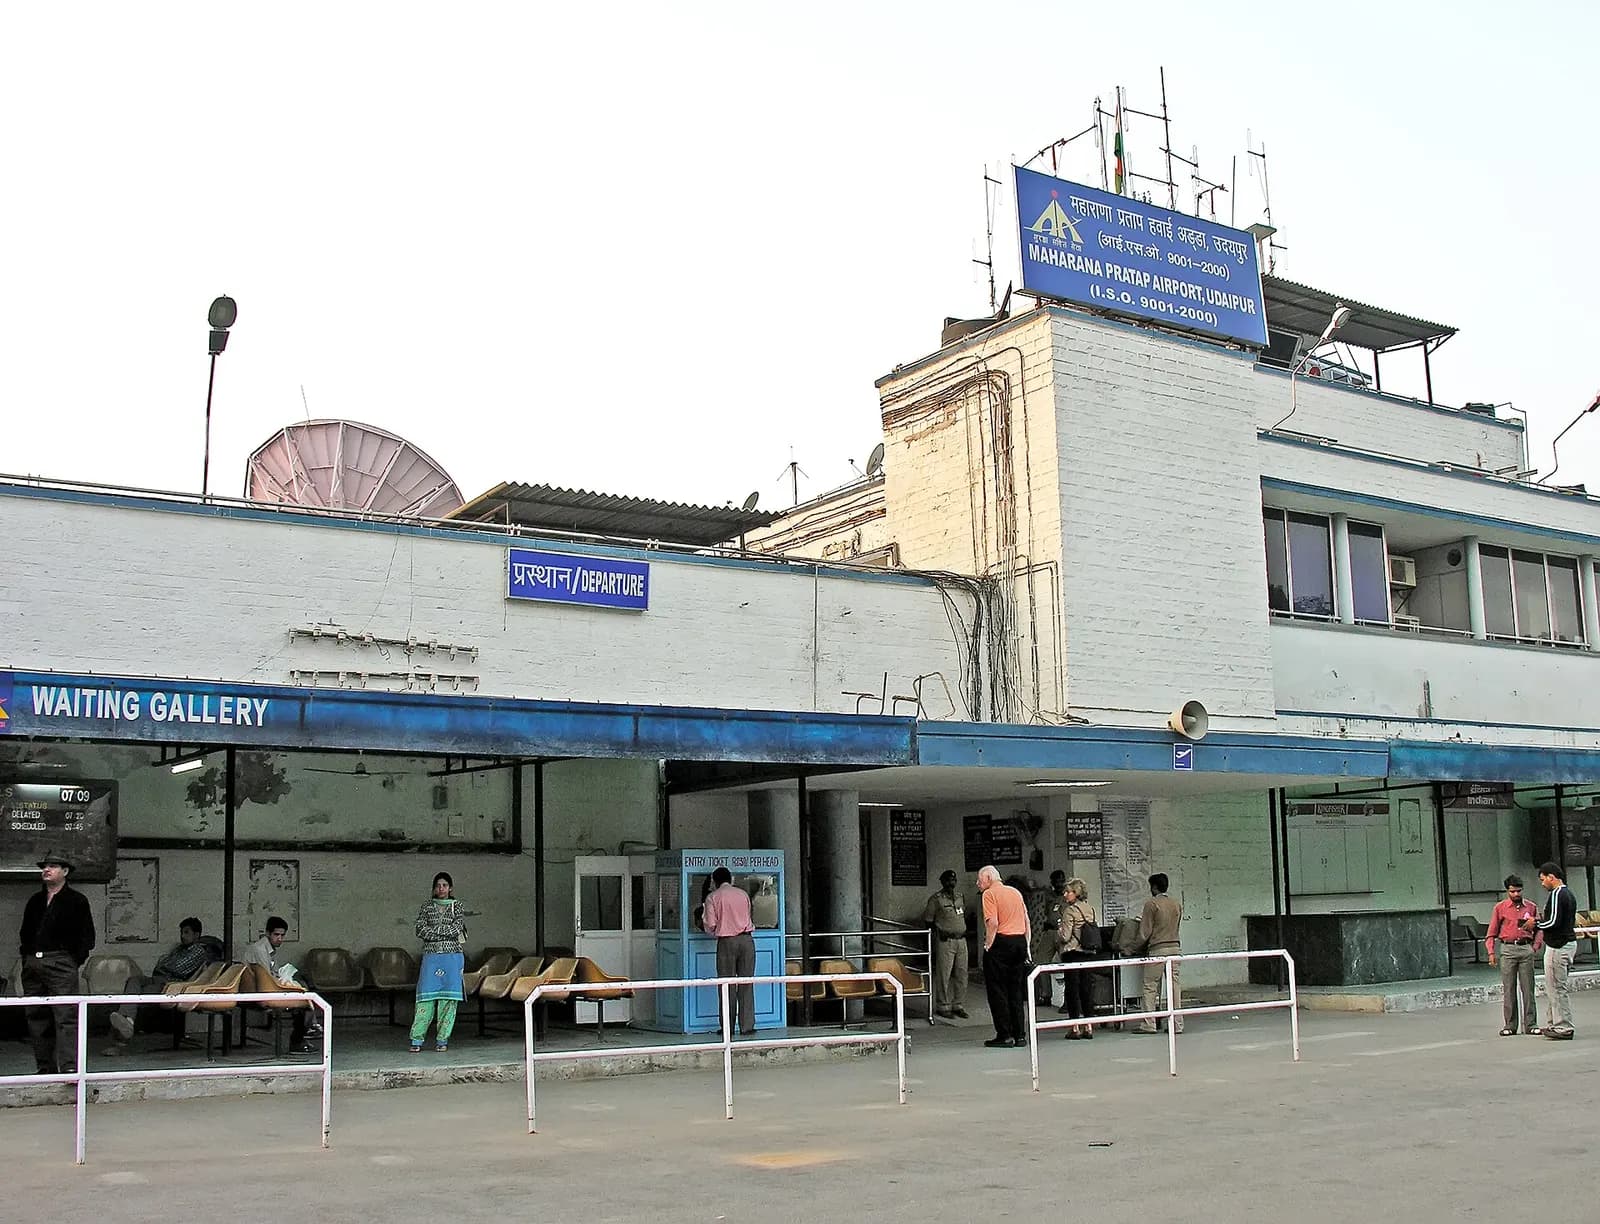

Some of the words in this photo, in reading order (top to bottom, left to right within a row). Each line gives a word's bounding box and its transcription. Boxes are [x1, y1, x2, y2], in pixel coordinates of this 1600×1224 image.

[1069, 195, 1112, 222] महाराणा
[1116, 208, 1144, 232] प्रताप
[1148, 216, 1173, 238] हवाई
[1212, 235, 1248, 264] उदयपुर
[1028, 244, 1103, 277] MAHARANA
[1106, 262, 1151, 289] PRATAP
[1206, 288, 1256, 315] UDAIPUR
[1089, 283, 1136, 306] (I.S.O.
[1140, 296, 1219, 327] 9001-2000)
[31, 685, 141, 721] WAITING
[149, 692, 270, 728] GALLERY
[11, 810, 41, 819] DELAYED
[11, 822, 47, 831] SCHEDULED
[685, 856, 706, 867] ENTRY
